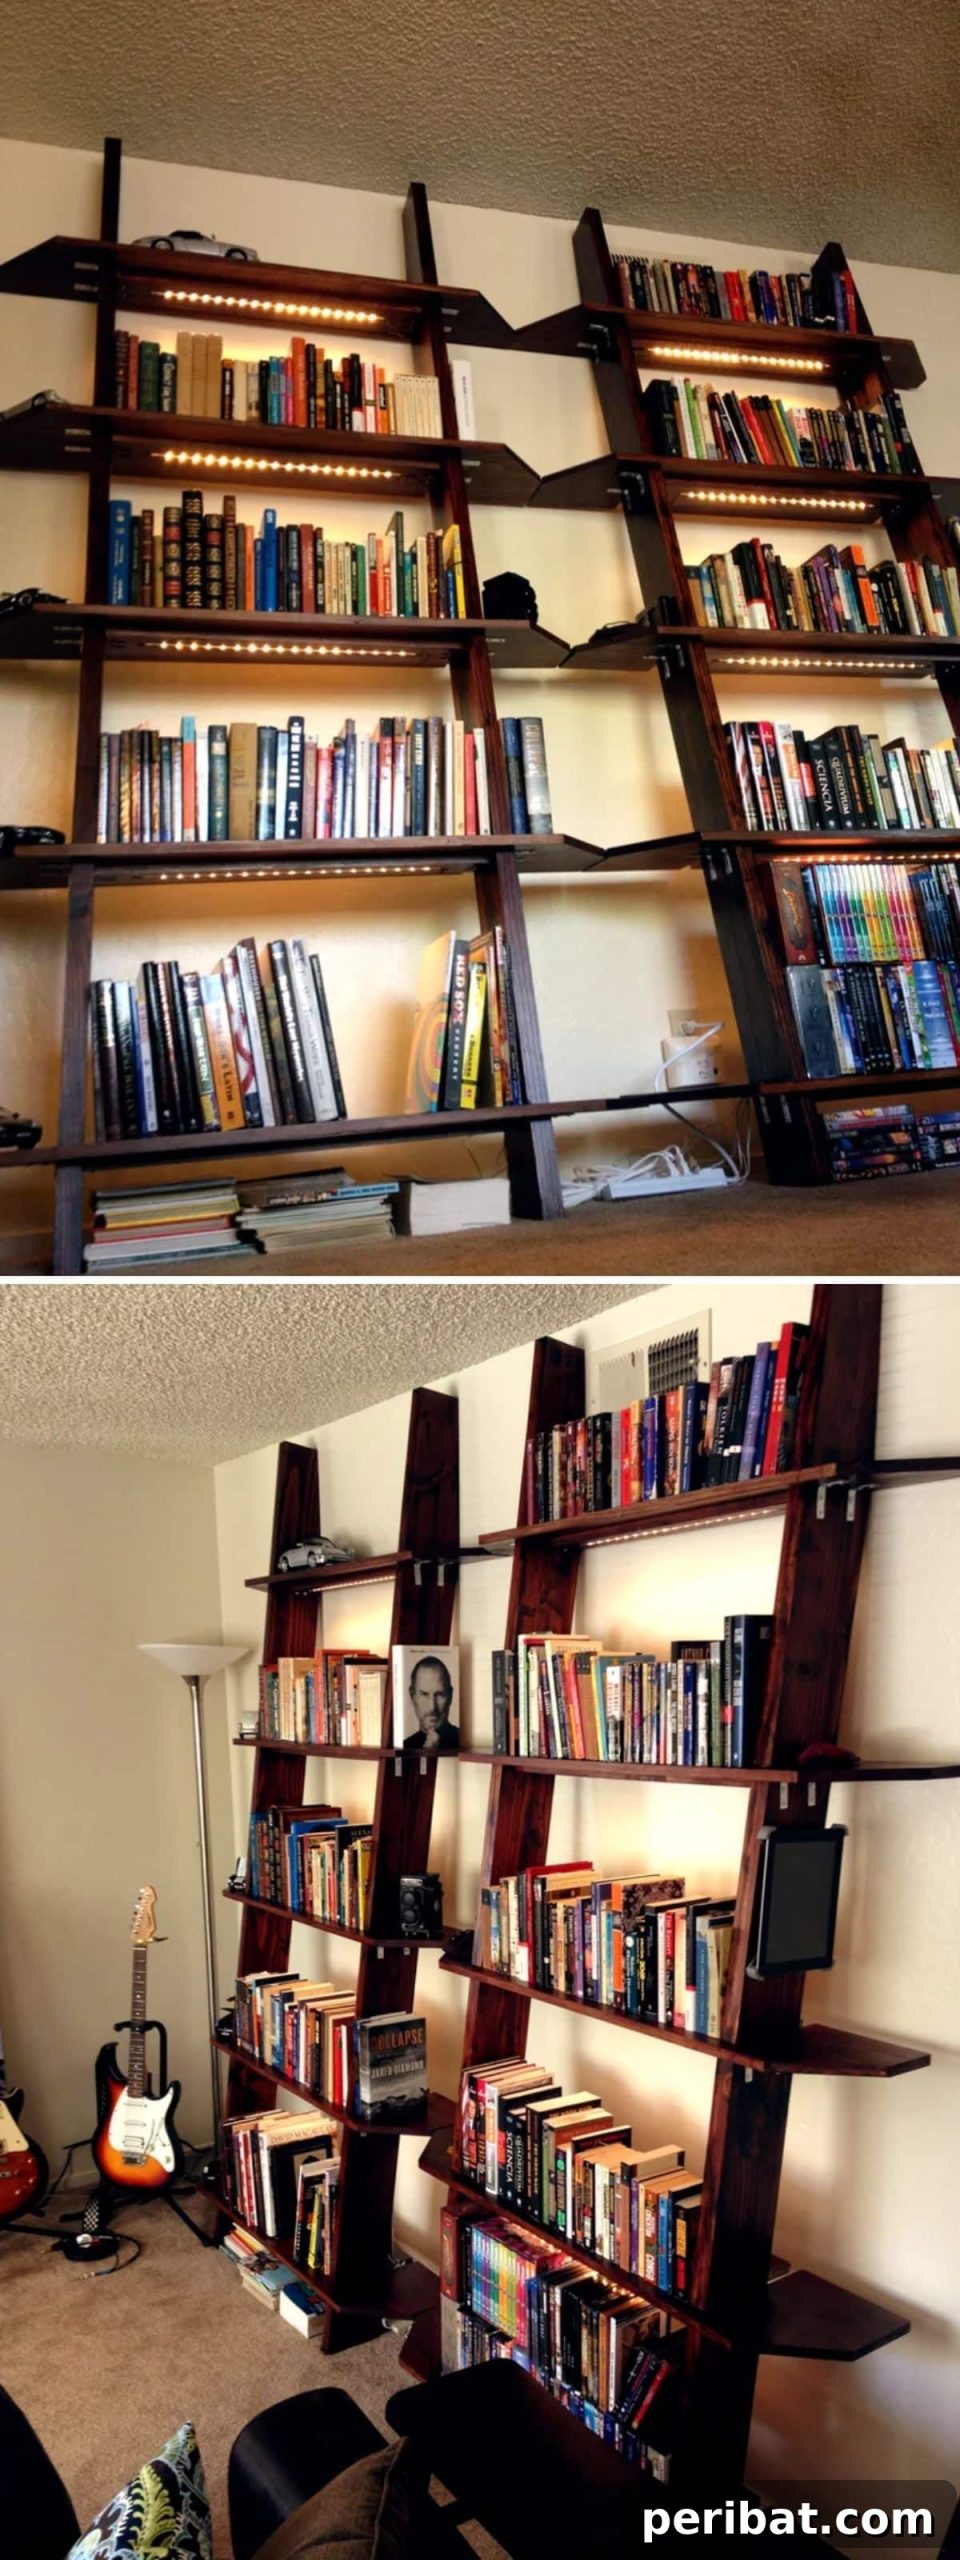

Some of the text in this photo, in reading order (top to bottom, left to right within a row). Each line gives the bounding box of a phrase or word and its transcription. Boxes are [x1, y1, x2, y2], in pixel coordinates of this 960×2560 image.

[815, 759, 833, 812] SCIENCIA
[832, 756, 851, 815] QUADRIVIUM
[454, 954, 466, 988] RED
[453, 990, 464, 1025] SOX
[717, 1405, 729, 1455] TOLKIEN
[370, 2028, 424, 2051] COLLAPSE
[371, 2060, 424, 2080] JARED DIAMOND
[505, 2131, 514, 2182] SCIENCIA
[515, 2135, 523, 2192] QUADRIVIUM
[645, 2253, 655, 2282] CONGO
